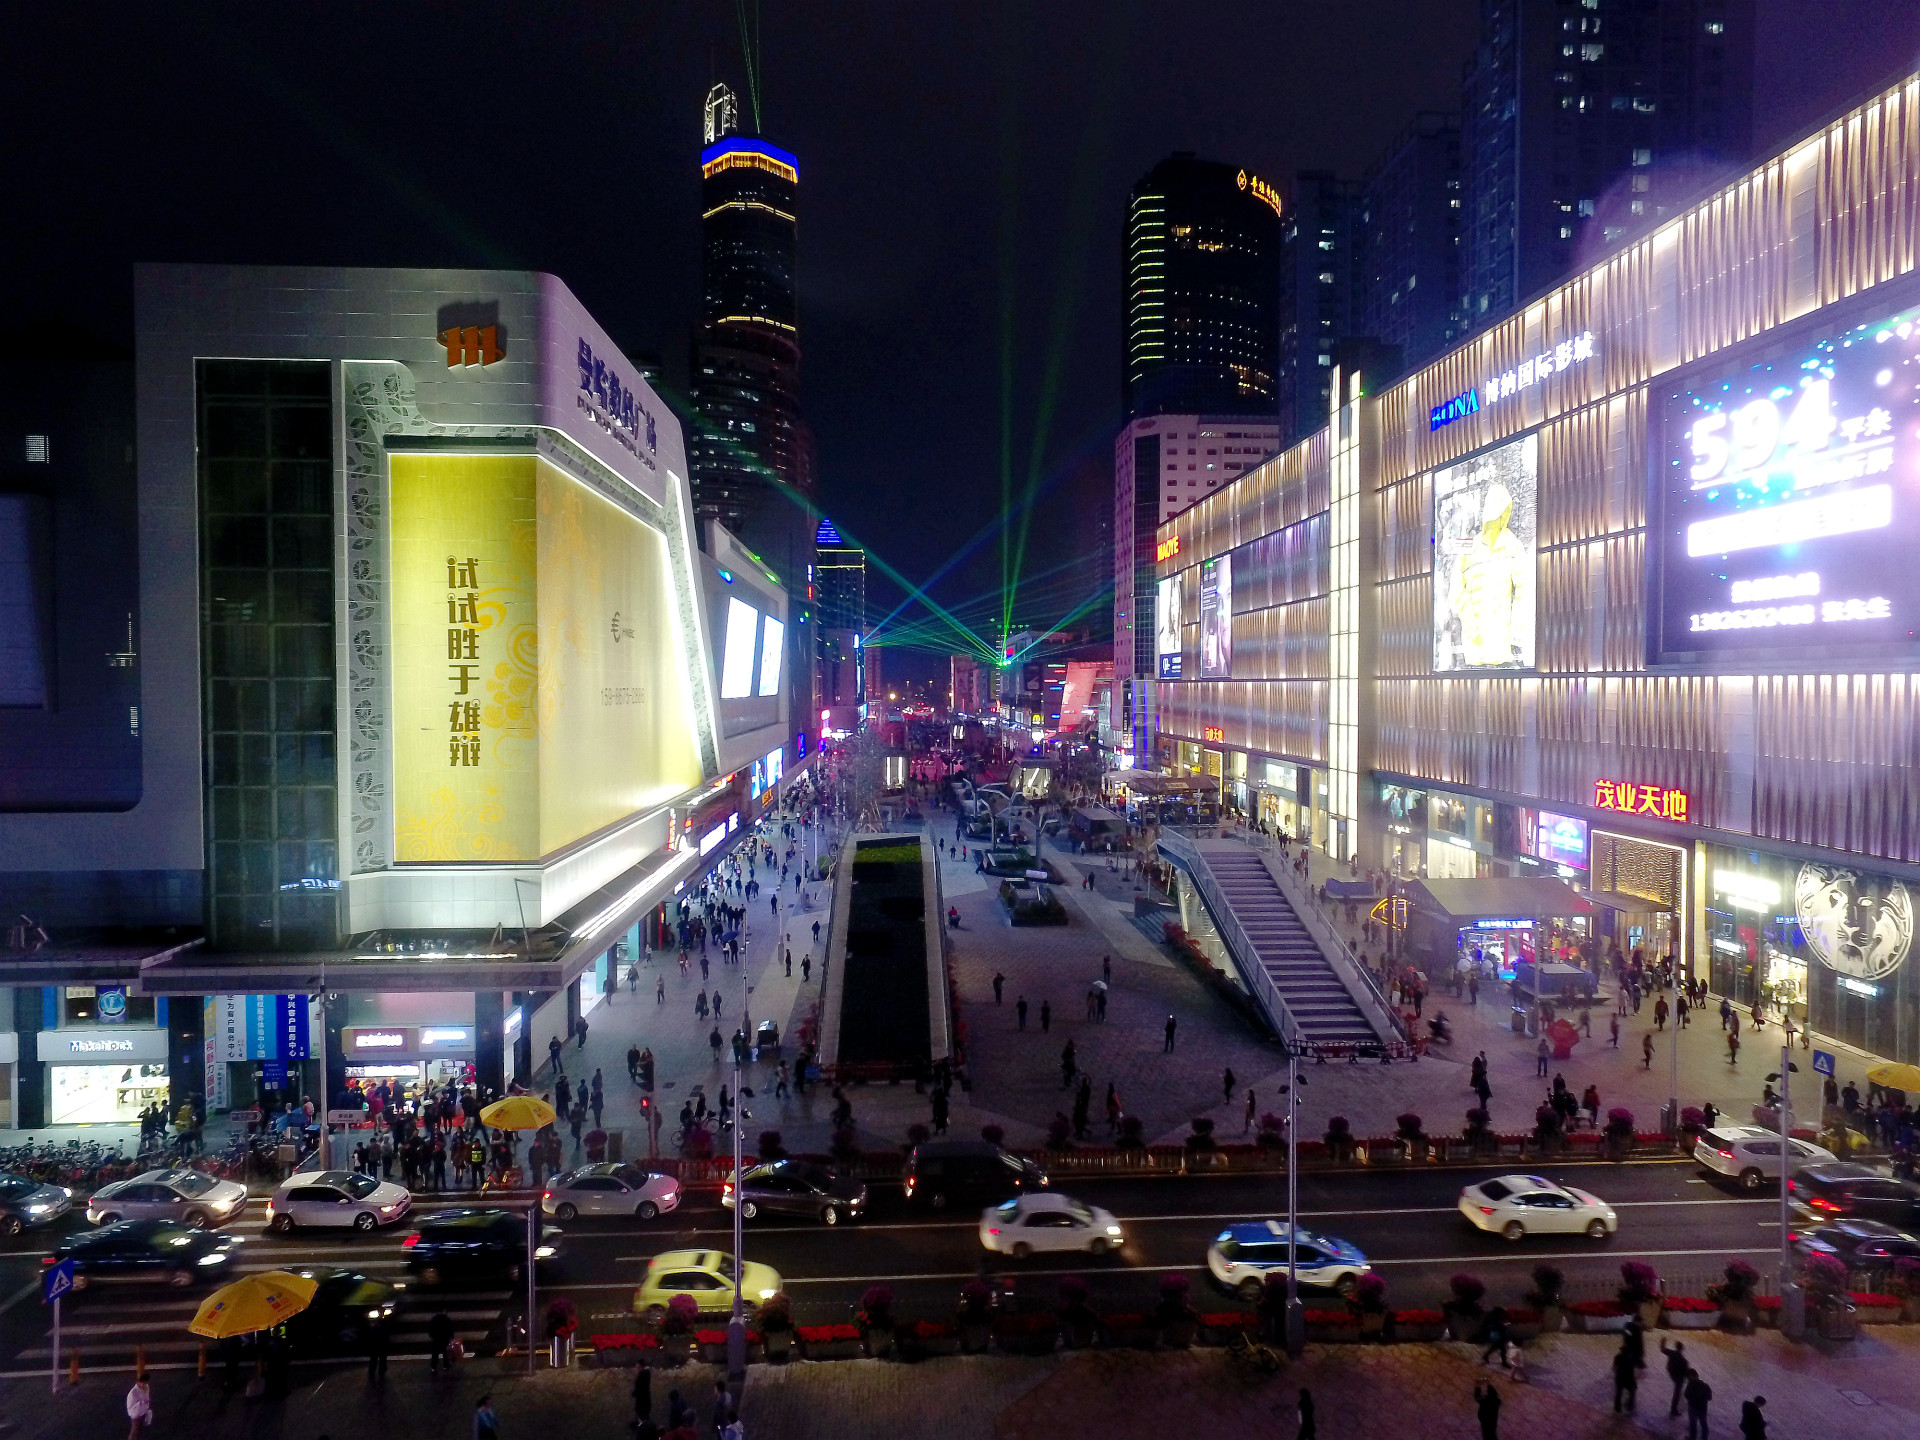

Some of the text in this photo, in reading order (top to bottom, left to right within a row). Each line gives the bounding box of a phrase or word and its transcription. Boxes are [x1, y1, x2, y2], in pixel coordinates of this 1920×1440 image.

[1431, 388, 1480, 431] BONA
[1690, 379, 1837, 480] 594
[447, 555, 480, 766] 试试胜于雄辩
[1594, 779, 1687, 821] 茂业天地
